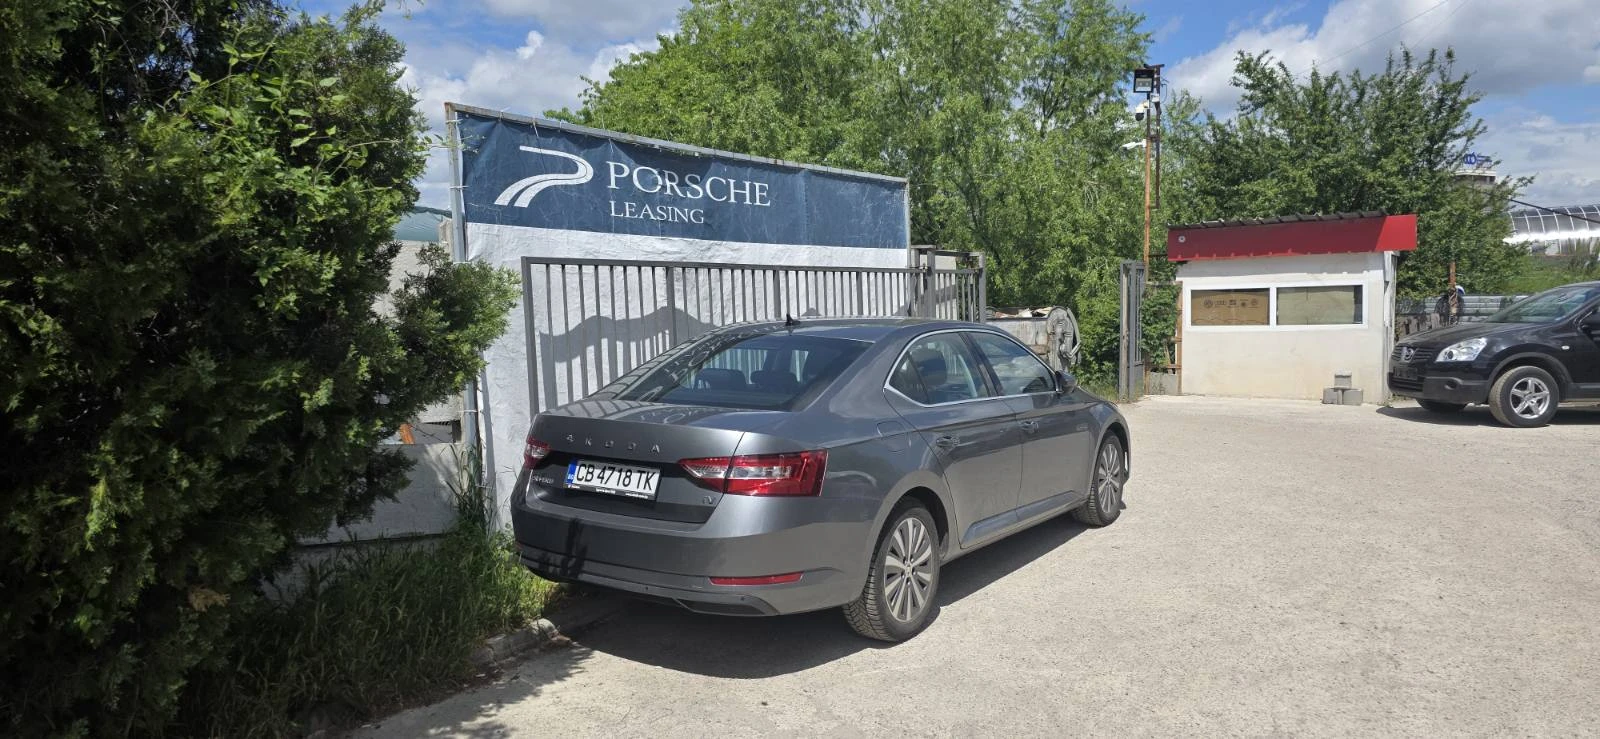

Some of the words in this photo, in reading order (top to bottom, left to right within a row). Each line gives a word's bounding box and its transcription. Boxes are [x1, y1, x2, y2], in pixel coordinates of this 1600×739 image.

[606, 161, 771, 207] PORSCHE
[609, 200, 704, 224] LEASING
[576, 464, 594, 482] CB
[597, 465, 632, 487] 4718
[637, 470, 656, 490] TK
